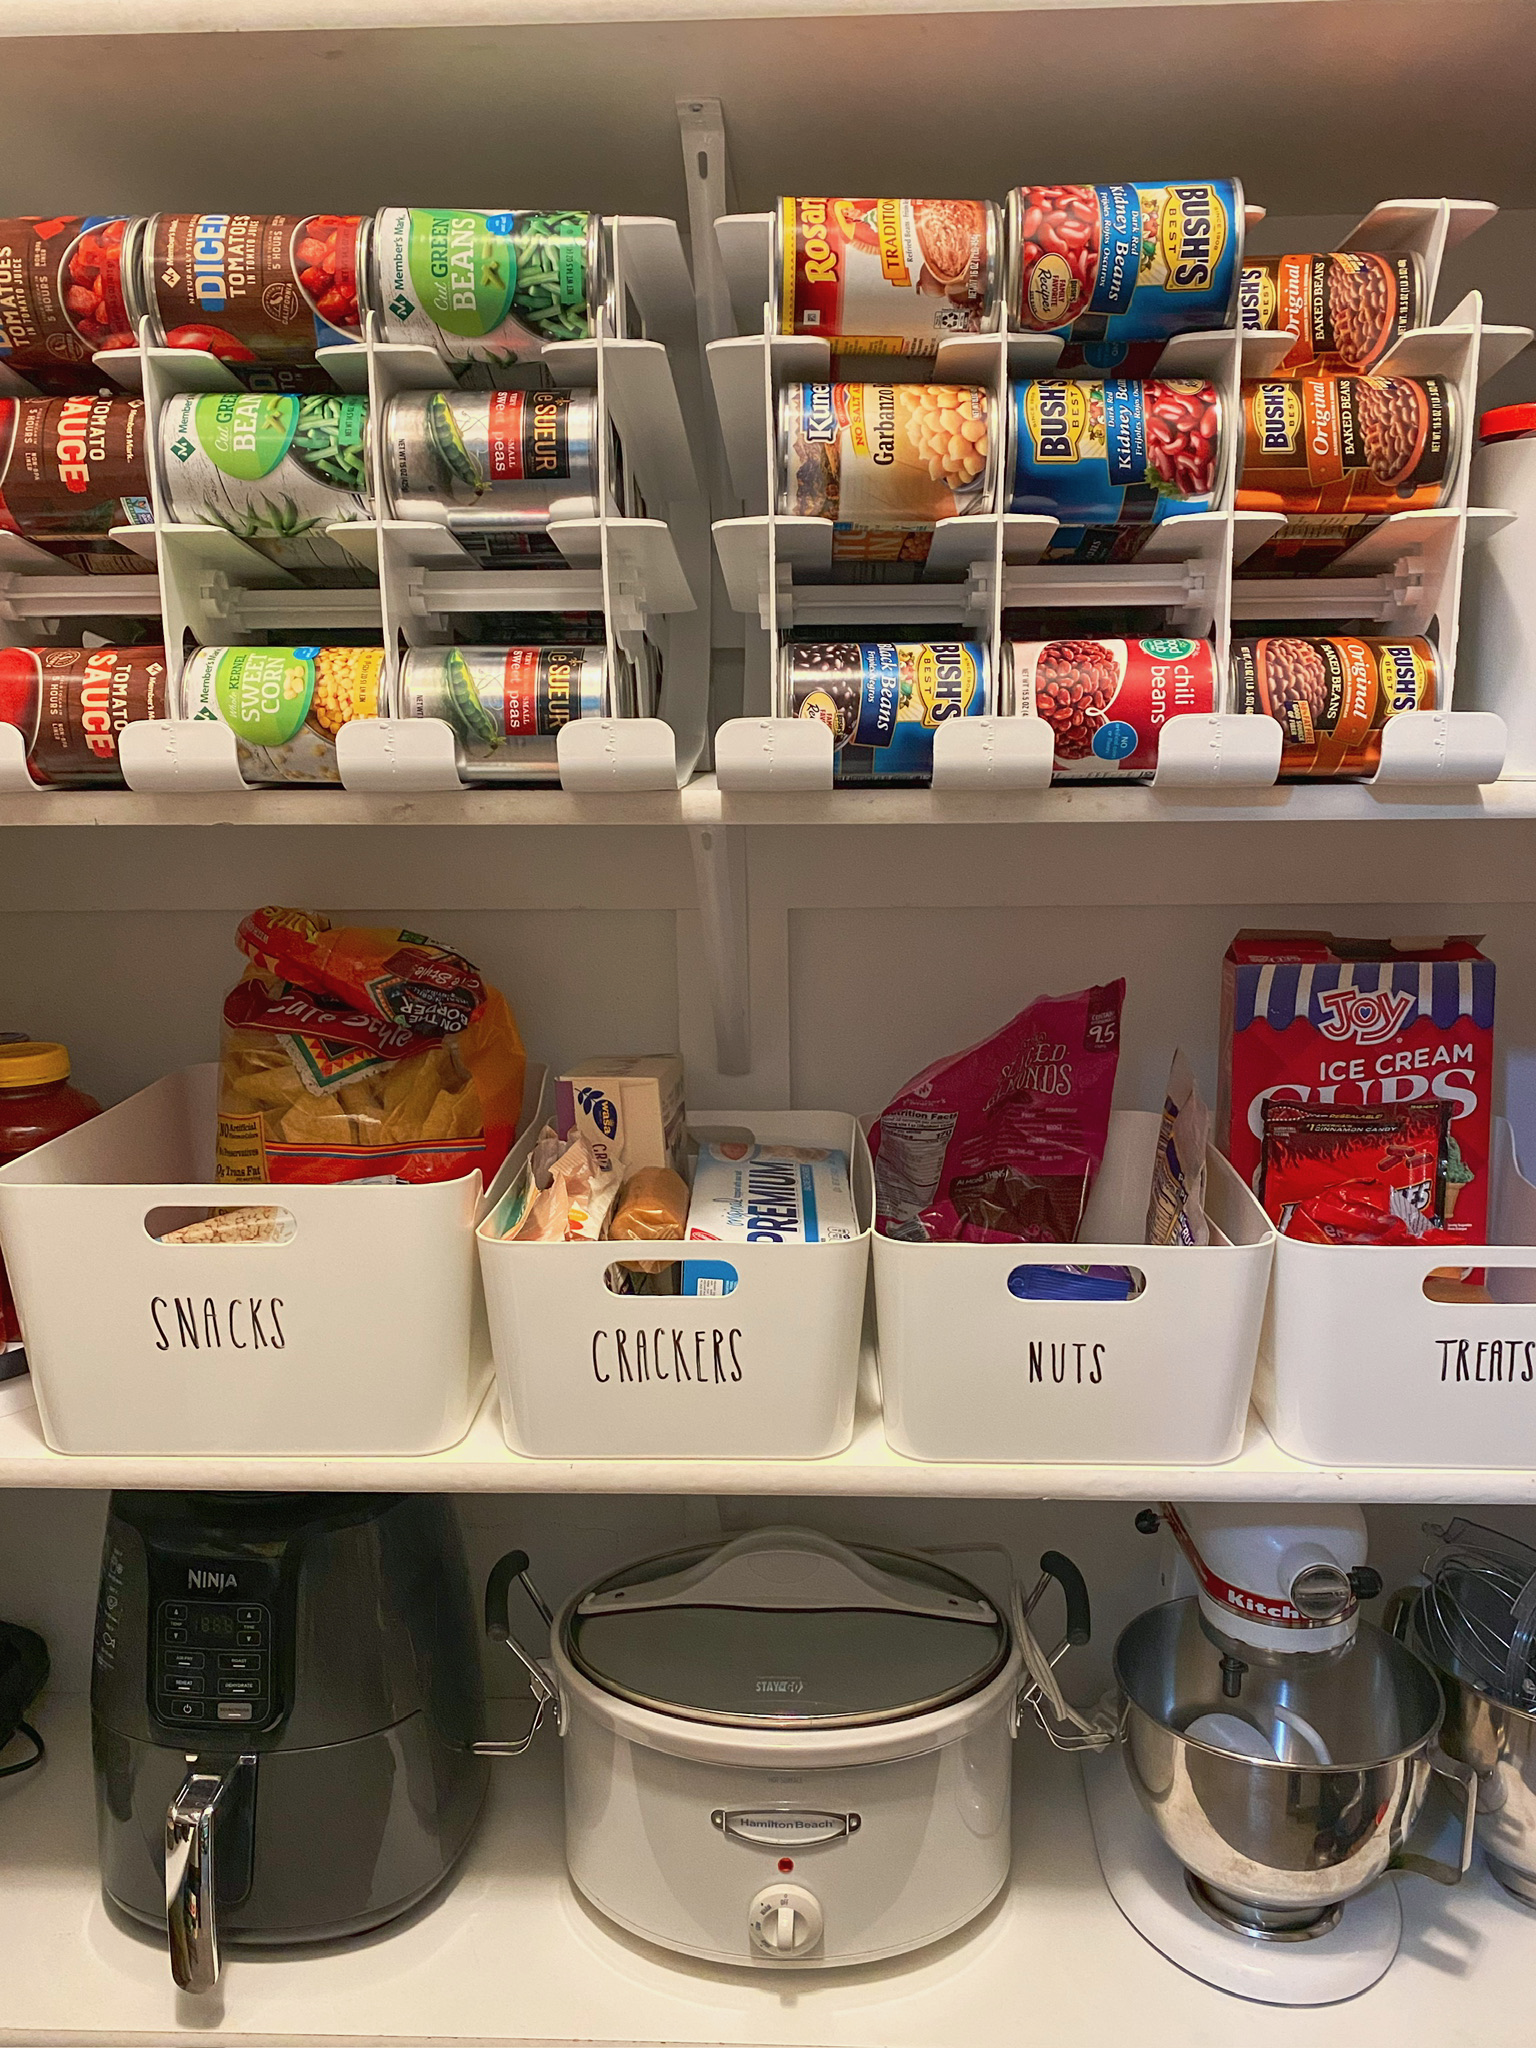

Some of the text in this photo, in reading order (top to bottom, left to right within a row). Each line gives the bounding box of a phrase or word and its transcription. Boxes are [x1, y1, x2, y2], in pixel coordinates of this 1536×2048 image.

[194, 214, 230, 299] DICED
[228, 215, 250, 298] TOMATOES
[273, 231, 282, 260] HOURS
[905, 239, 914, 263] Refried
[1102, 219, 1112, 244] Rojos
[1108, 185, 1129, 301] Kidney Beans
[1131, 210, 1140, 256] Dark Red
[1168, 209, 1178, 253] BEST
[1174, 187, 1211, 286] BUSH'S
[13, 258, 23, 285] JUICE
[186, 252, 195, 304] NATURALLY
[246, 237, 255, 284] IN TOMATO
[393, 236, 405, 291] Member's
[431, 217, 450, 311] Cut GREEN
[451, 218, 477, 311] BEANS
[1099, 247, 1112, 287] Oscuros
[16, 288, 31, 323] TOMATO
[40, 276, 54, 312] HOURS
[282, 282, 293, 325] CALIFORNIA
[1036, 268, 1052, 314] Recipes
[1051, 275, 1060, 307] FAVORITE
[1058, 279, 1066, 303] FAMILY
[1285, 263, 1303, 339] Original
[1313, 261, 1325, 341] BAKED BEANS
[24, 415, 35, 444] HOURS
[89, 400, 112, 461] TOMATO
[233, 394, 263, 452] BEAN
[807, 383, 832, 441] Kune
[852, 396, 861, 423] SALT
[873, 389, 895, 466] Garbanzo
[1037, 379, 1072, 457] BUSH'S
[1071, 391, 1079, 428] BEST
[1107, 408, 1115, 428] Dark
[1133, 401, 1145, 456] Frijoles Rojos
[1265, 384, 1288, 448] BUSH'S
[1288, 396, 1296, 427] BEST
[1311, 380, 1330, 456] Original
[1341, 380, 1355, 456] BAKED BEANS
[215, 426, 229, 452] Cut
[492, 431, 506, 471] peas
[508, 438, 516, 468] SMALL
[533, 405, 557, 471] SUEUR
[854, 427, 865, 446] NO
[1116, 404, 1134, 470] Kidney
[49, 683, 59, 715] HOURS
[80, 654, 118, 750] SAUCE
[111, 664, 132, 732] TOMATO
[201, 660, 215, 703] Member's
[229, 654, 247, 718] Whole KERNEL
[241, 653, 267, 722] SWEET
[261, 657, 285, 714] CORN
[508, 650, 523, 728] sweet peas
[522, 652, 533, 725] VERY SMALL
[548, 664, 571, 729] SUEUR
[877, 643, 898, 731] Black Beans
[929, 645, 963, 722] BUSH'S
[1150, 665, 1171, 724] beans
[1173, 664, 1195, 705] chili
[1322, 644, 1343, 719] BAKED BEANS
[1347, 644, 1368, 719] Original
[1384, 661, 1393, 690] BEST
[1388, 647, 1416, 711] BUSH'S
[1120, 736, 1128, 749] NO
[440, 1019, 461, 1032] ON
[1320, 1043, 1474, 1081] ICE CREAM
[601, 1100, 612, 1135] wasa
[747, 1160, 798, 1242] PREMIUM
[151, 1297, 285, 1351] SNACKS
[592, 1328, 743, 1384] CRACKERS
[1029, 1341, 1106, 1384] NUTS
[1435, 1339, 1536, 1382] TREATS
[188, 1568, 238, 1594] NINJA
[756, 1681, 779, 1692] STAY
[740, 1818, 833, 1829] Hamilton Beach
